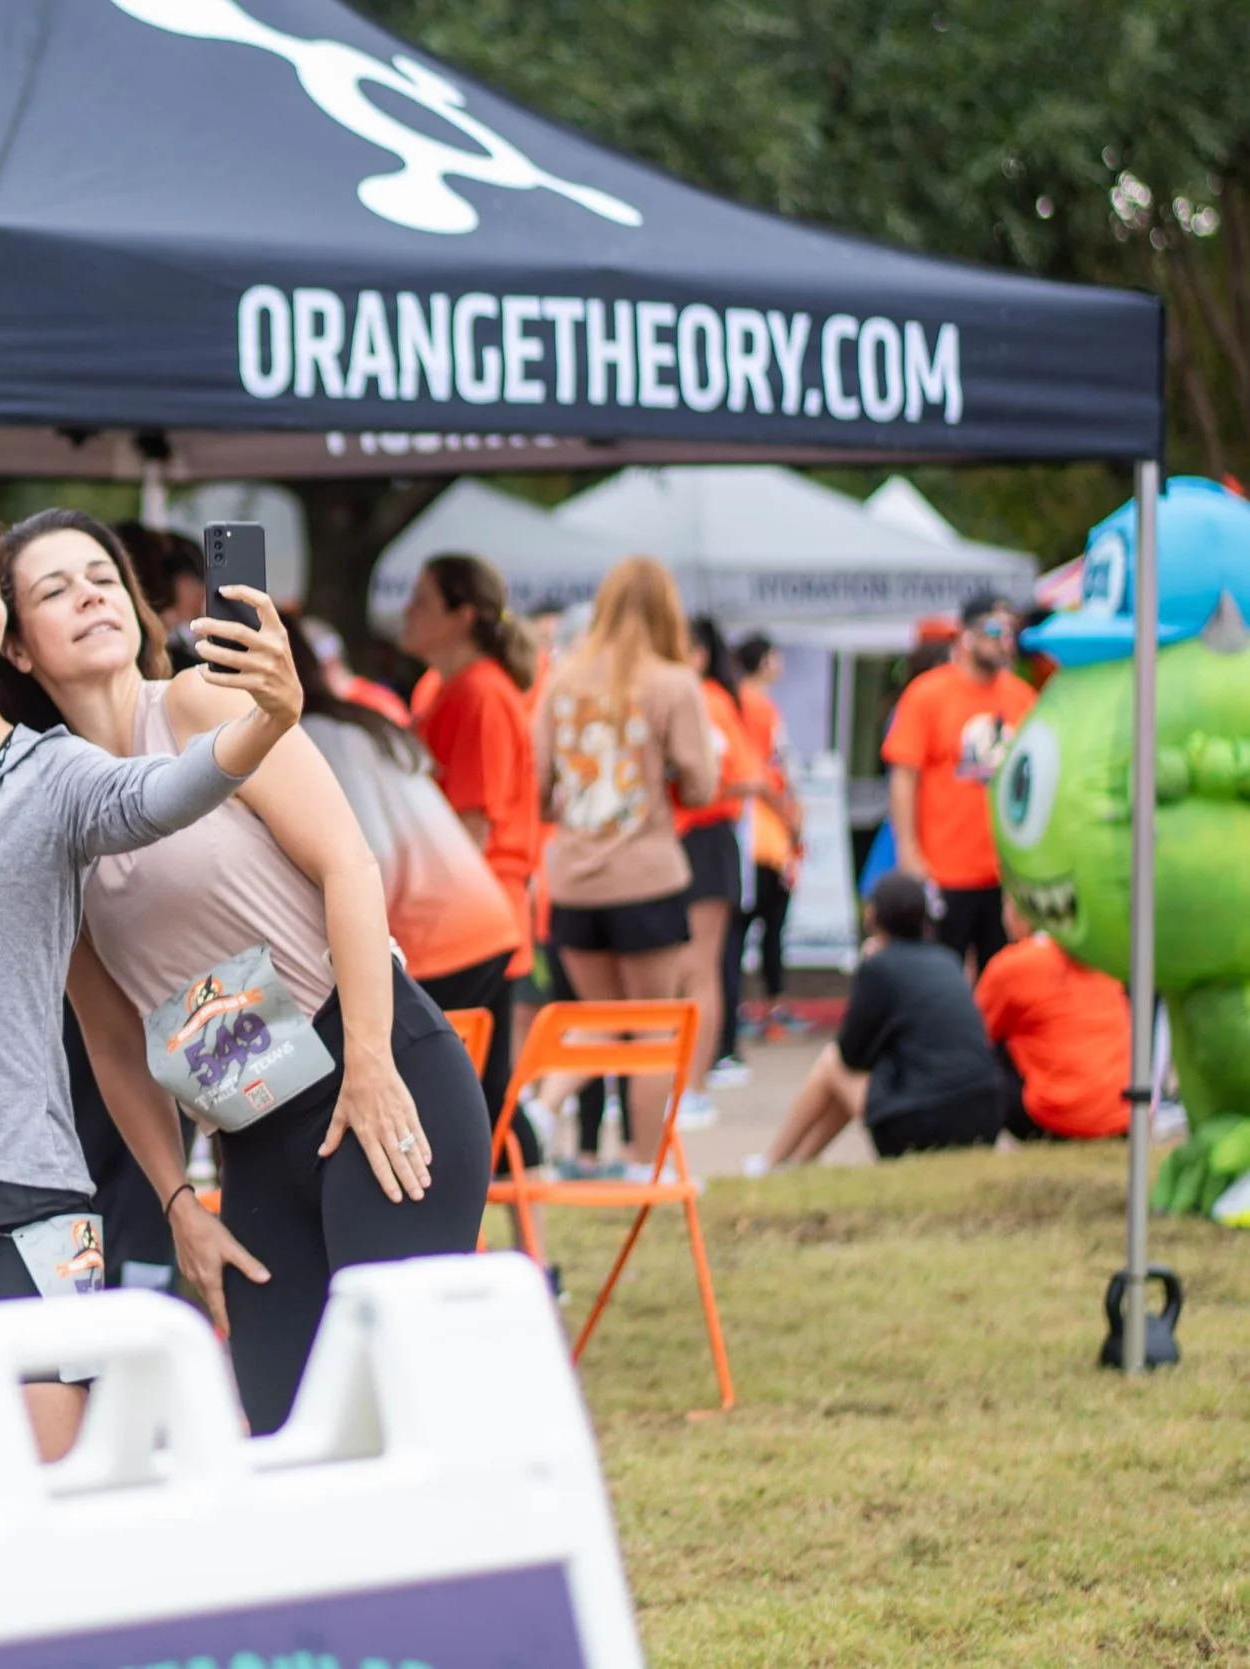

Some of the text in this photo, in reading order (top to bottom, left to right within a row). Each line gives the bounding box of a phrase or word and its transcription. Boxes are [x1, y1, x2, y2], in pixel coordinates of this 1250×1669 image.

[238, 285, 963, 423] ORANGETHEORY.COM
[184, 1012, 272, 1086] 549
[249, 1041, 294, 1074] TEXANS
